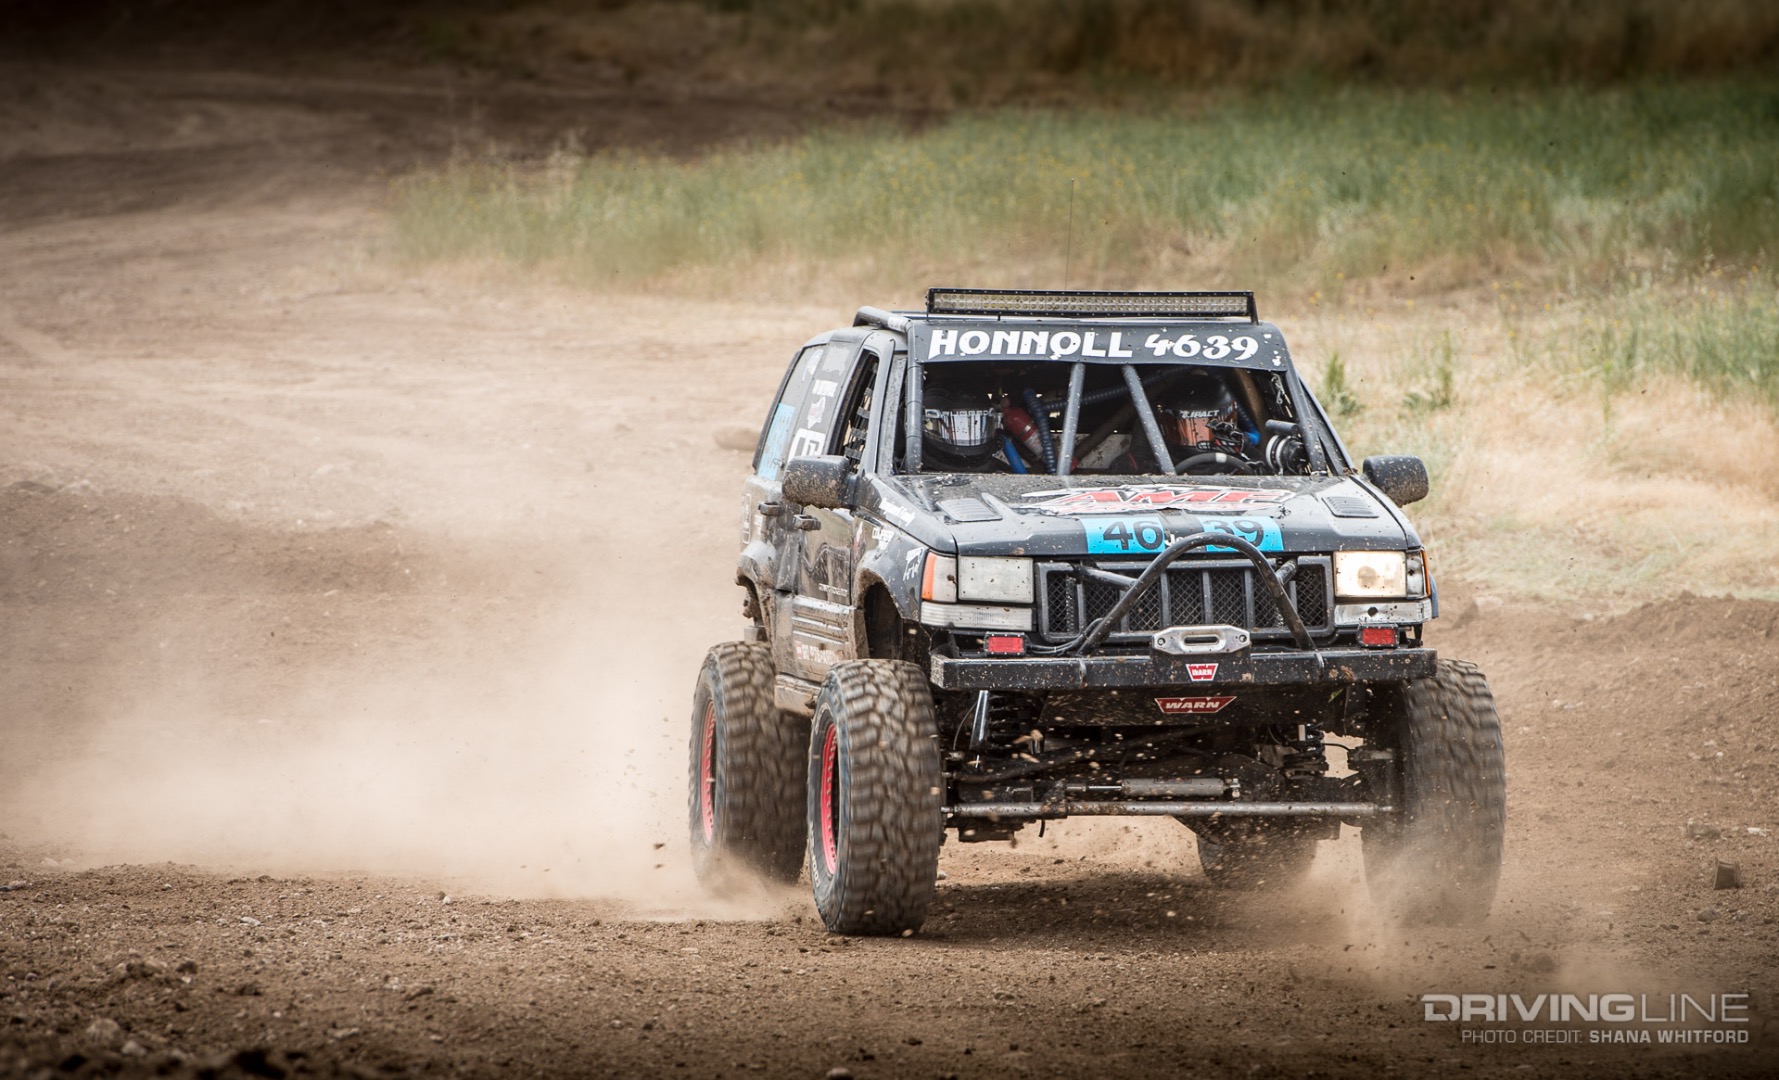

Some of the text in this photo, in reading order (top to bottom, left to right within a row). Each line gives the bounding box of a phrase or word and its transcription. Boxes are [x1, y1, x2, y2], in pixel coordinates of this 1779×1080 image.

[928, 329, 1259, 361] HONNOLL 4639
[1103, 521, 1163, 550] 46
[1191, 668, 1213, 677] WARN
[1165, 701, 1220, 709] WARN
